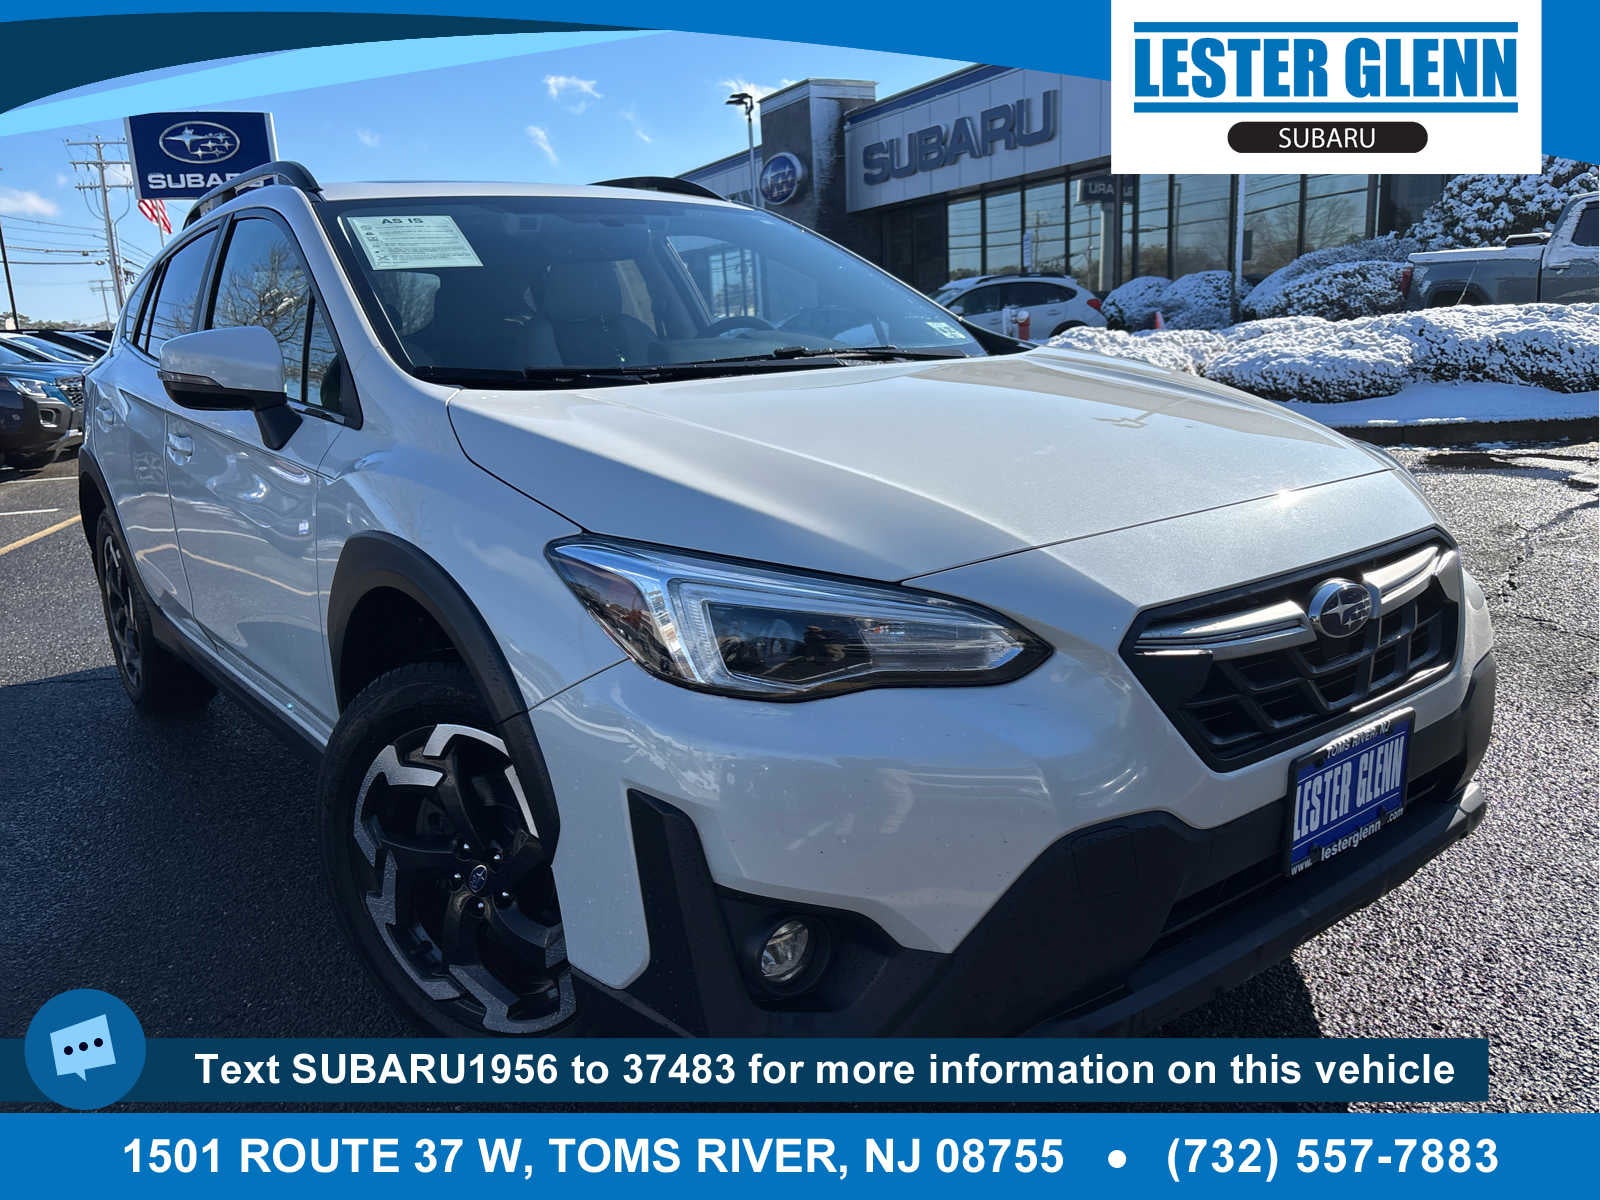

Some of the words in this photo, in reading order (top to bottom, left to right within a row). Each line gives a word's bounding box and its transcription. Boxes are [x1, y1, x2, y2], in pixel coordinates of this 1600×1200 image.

[863, 90, 1058, 186] SUBARU
[381, 217, 403, 225] AS
[1293, 761, 1353, 842] LESTER
[1356, 736, 1405, 808] GLENN
[1321, 820, 1381, 862] lesterglenn
